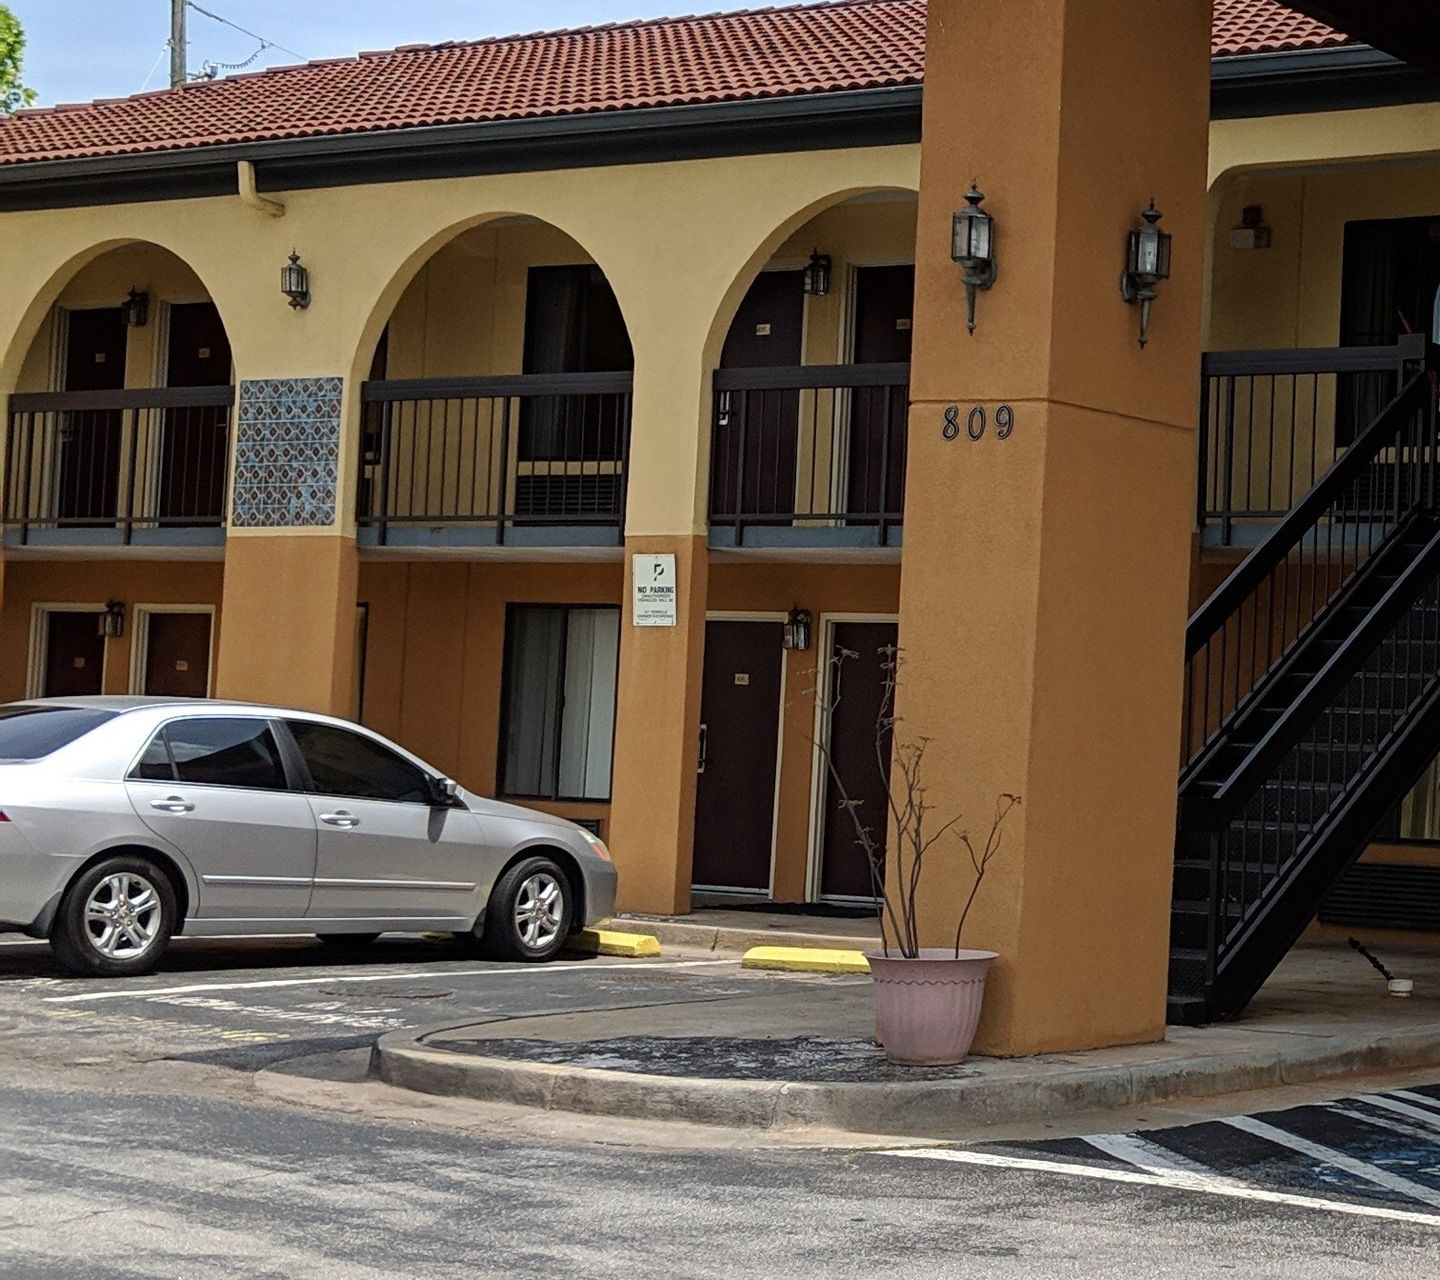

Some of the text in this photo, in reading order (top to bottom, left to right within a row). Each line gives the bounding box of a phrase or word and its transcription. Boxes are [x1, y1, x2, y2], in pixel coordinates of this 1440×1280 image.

[942, 405, 1014, 441] 809
[637, 586, 674, 594] NO PARKING
